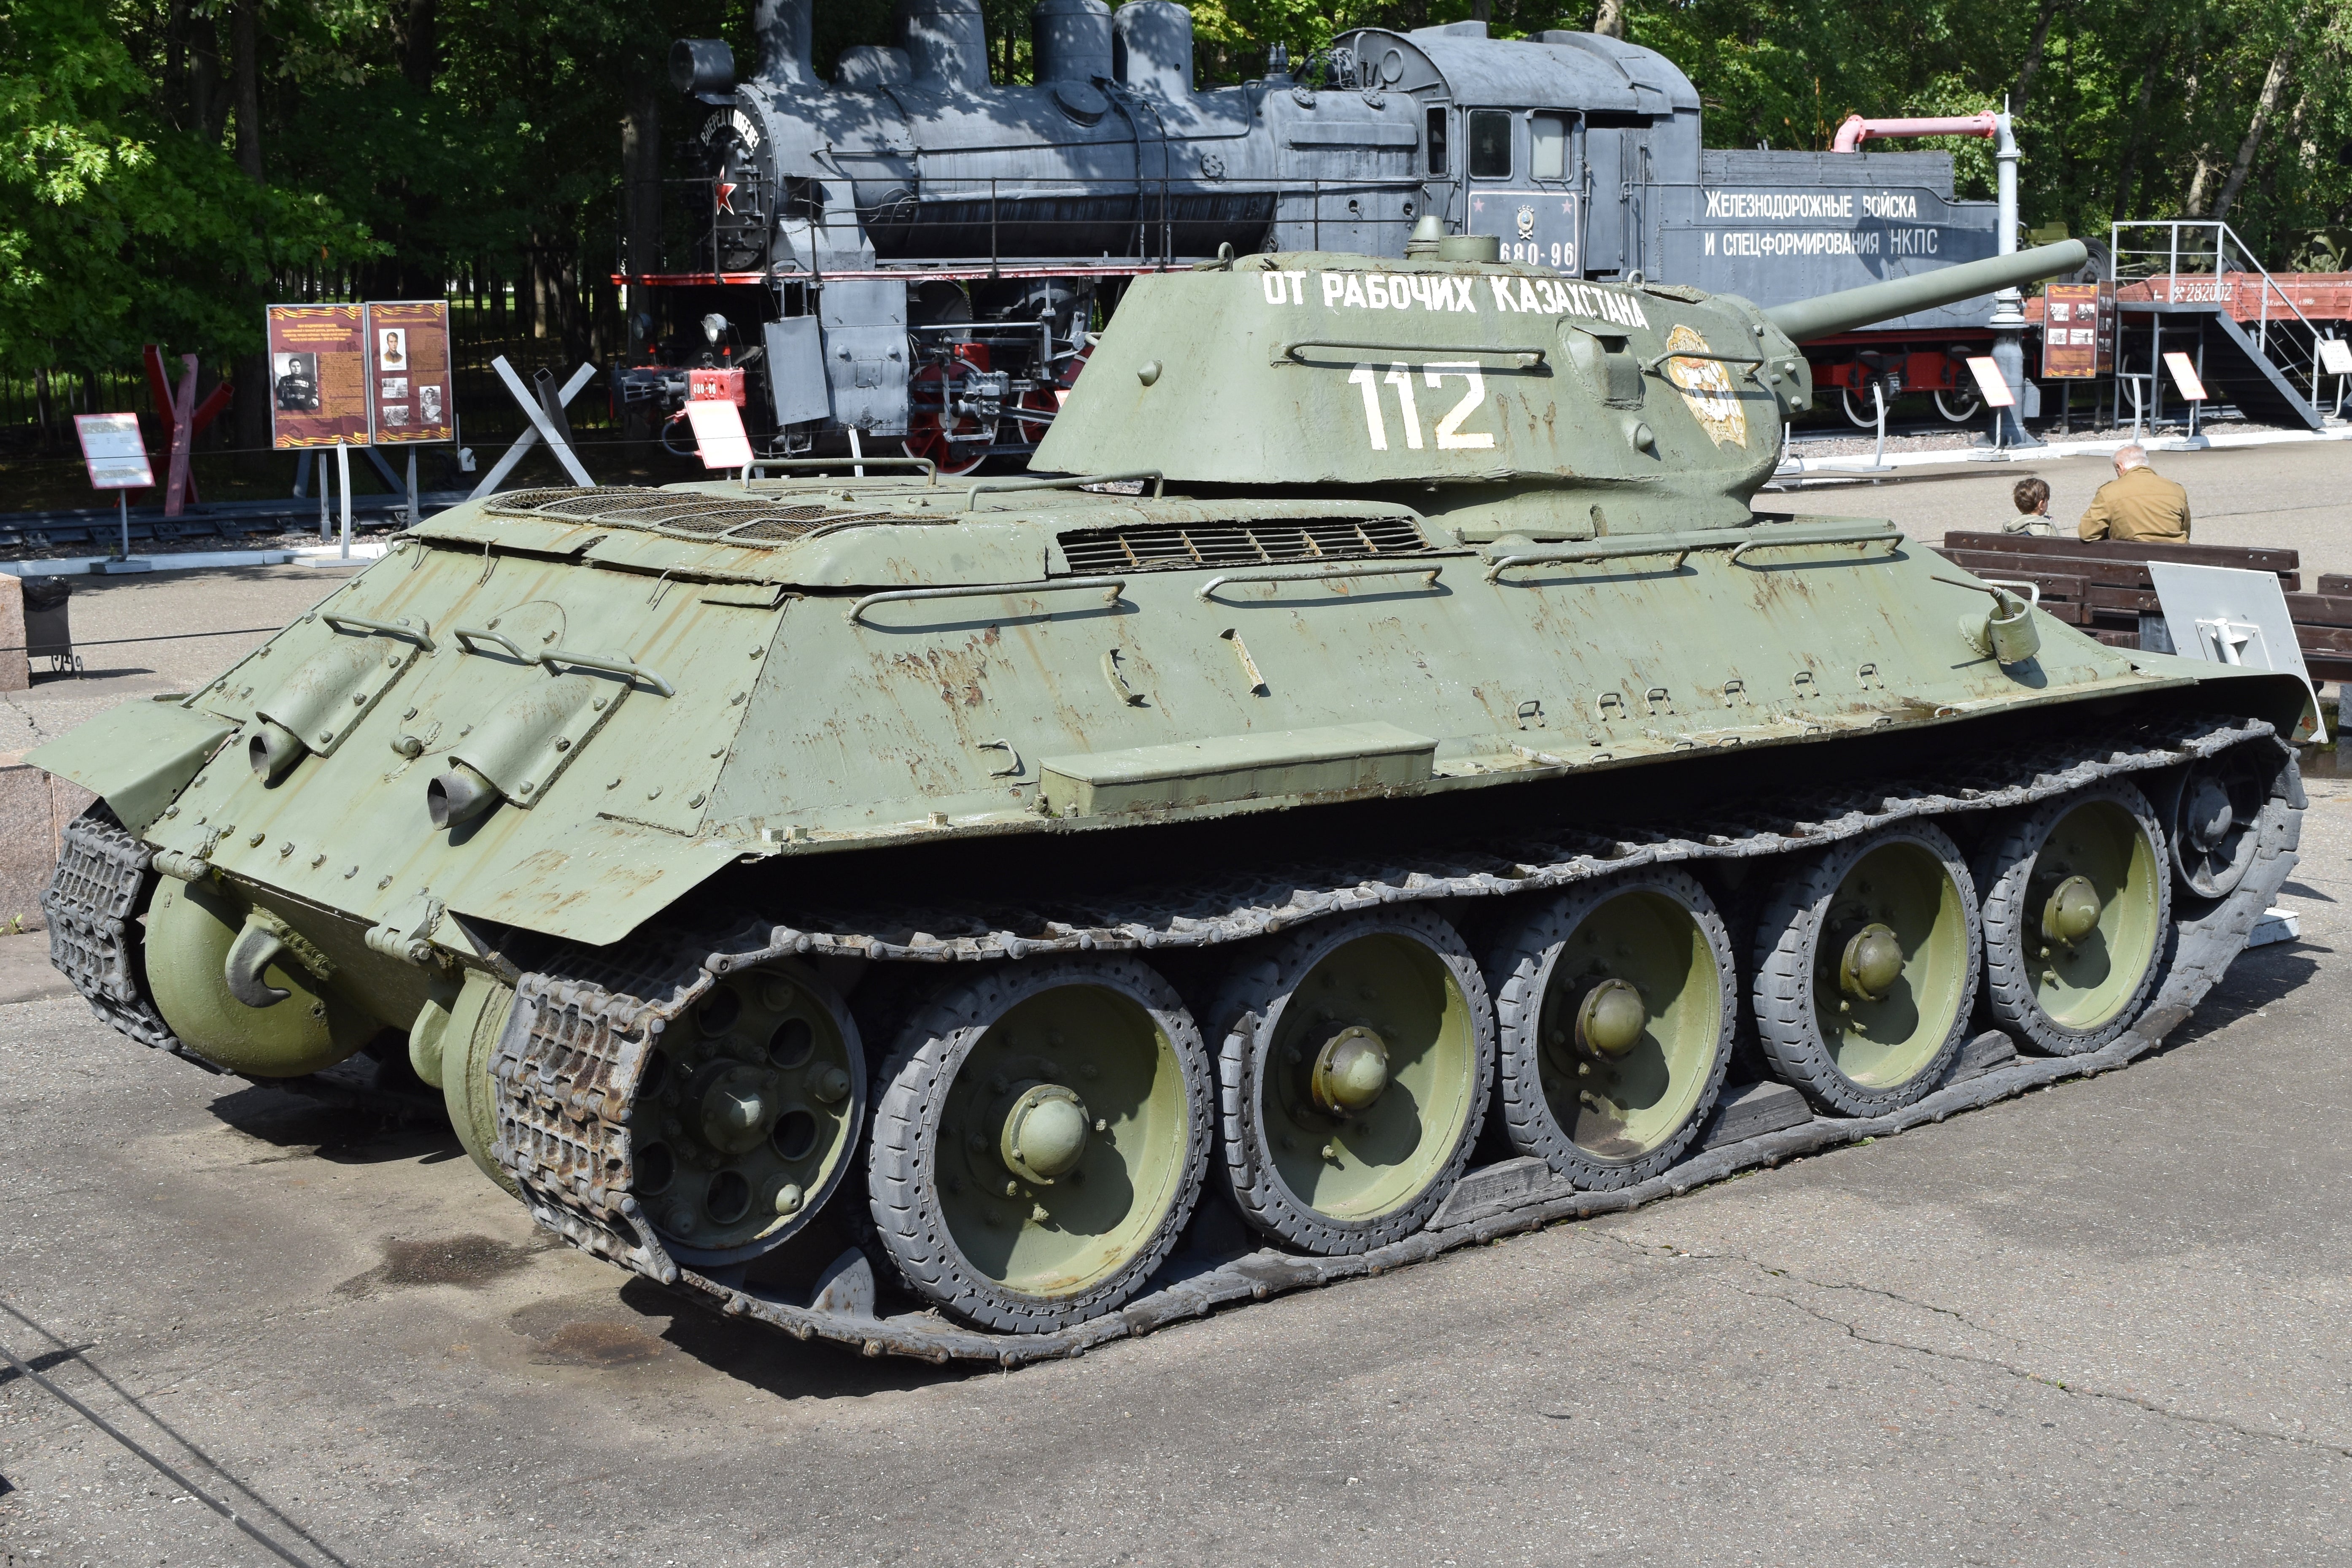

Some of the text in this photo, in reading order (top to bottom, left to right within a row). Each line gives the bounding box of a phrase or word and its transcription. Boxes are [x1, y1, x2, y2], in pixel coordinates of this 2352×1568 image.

[701, 108, 760, 151] ВПЕРЕД К ПОБЕДЕ!
[1705, 191, 1917, 219] ЖЕЛЕЗНОДОРОЖНЫЕ ВОЙСКА
[1500, 243, 1574, 266] 680-96
[1705, 229, 1937, 258] И СПЕЦФОРМИРОВАНИЯ НКПС
[1262, 270, 1650, 330] ОТ РАБОЧИХ КАЗАХСТАНА
[693, 383, 716, 394] 680-96
[1348, 361, 1495, 451] 112
